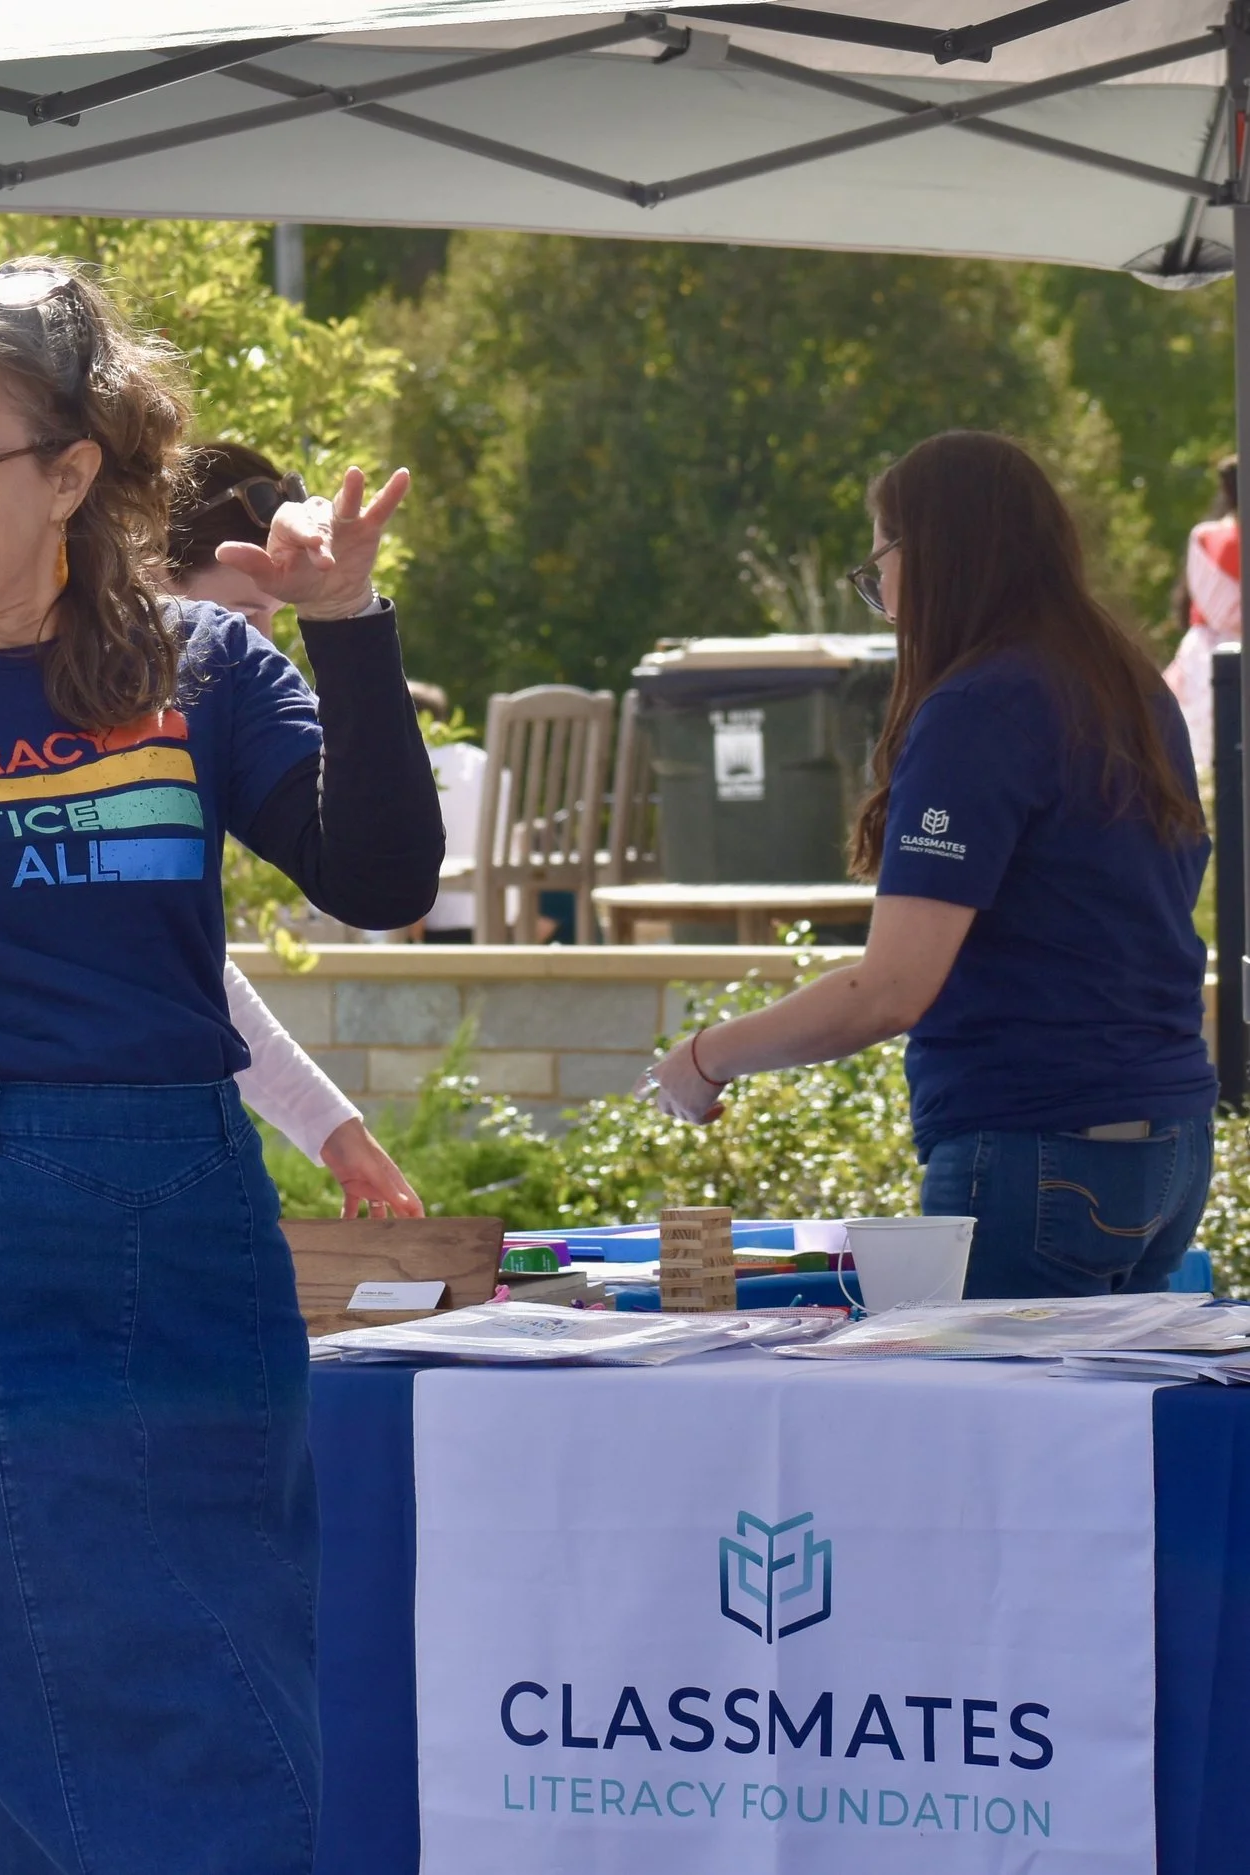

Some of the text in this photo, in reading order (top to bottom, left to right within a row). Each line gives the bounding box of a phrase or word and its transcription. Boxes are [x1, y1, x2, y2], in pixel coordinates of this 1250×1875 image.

[12, 840, 121, 888] ALL
[900, 835, 966, 853] CLASSMATES
[500, 1680, 1054, 1771] CLASSMATES
[503, 1774, 1052, 1838] LITERACY FOUNDATION
